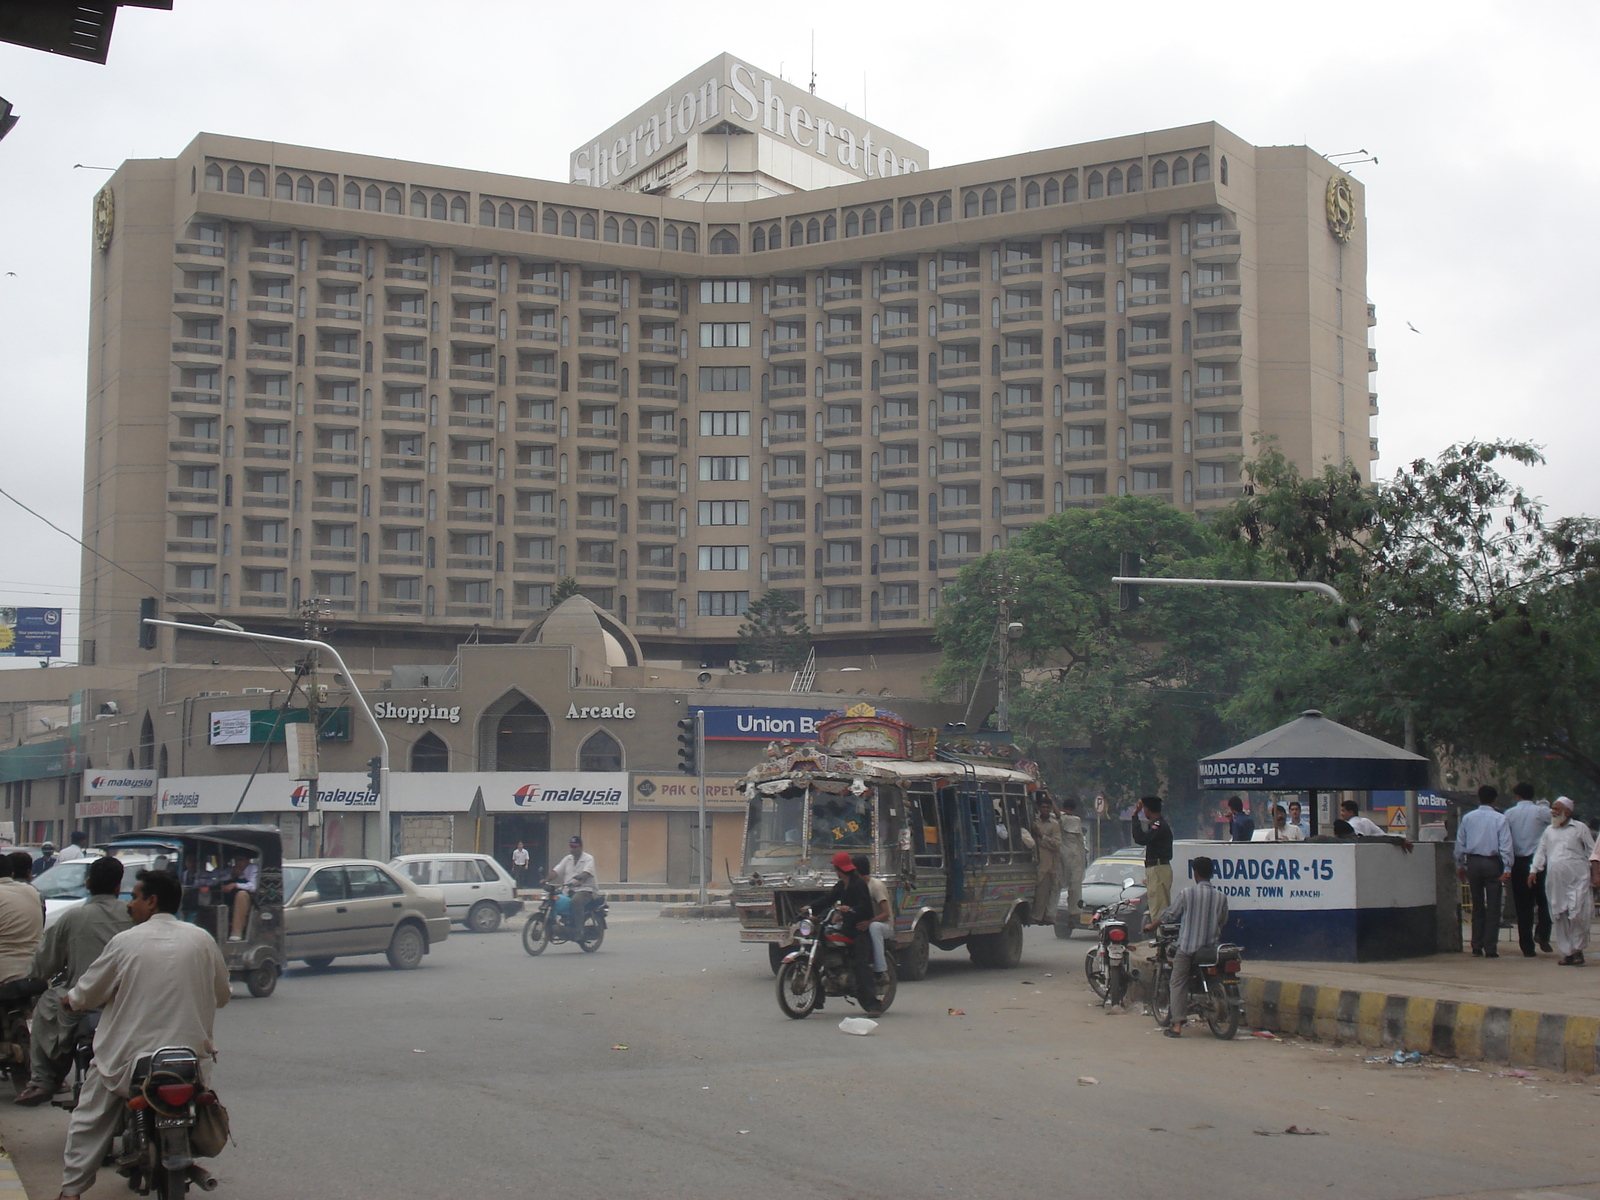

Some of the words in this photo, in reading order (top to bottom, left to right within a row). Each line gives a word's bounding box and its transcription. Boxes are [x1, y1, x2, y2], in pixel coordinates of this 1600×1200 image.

[730, 62, 921, 179] Sheraton
[573, 76, 721, 188] Sheraton
[373, 701, 461, 724] Shopping
[565, 702, 636, 720] Arcade
[737, 714, 795, 733] Union
[107, 778, 153, 789] malaysia
[1237, 776, 1263, 784] KARACHI
[317, 788, 378, 806] malaysia
[540, 787, 622, 805] malaysia
[661, 784, 686, 796] PAK
[689, 785, 735, 796] CRPET
[168, 791, 200, 808] malaysia
[1430, 794, 1448, 807] Bank
[1188, 858, 1334, 881] ADADGAR-15
[1212, 886, 1251, 898] ADDAR
[1256, 886, 1284, 898] TOWN
